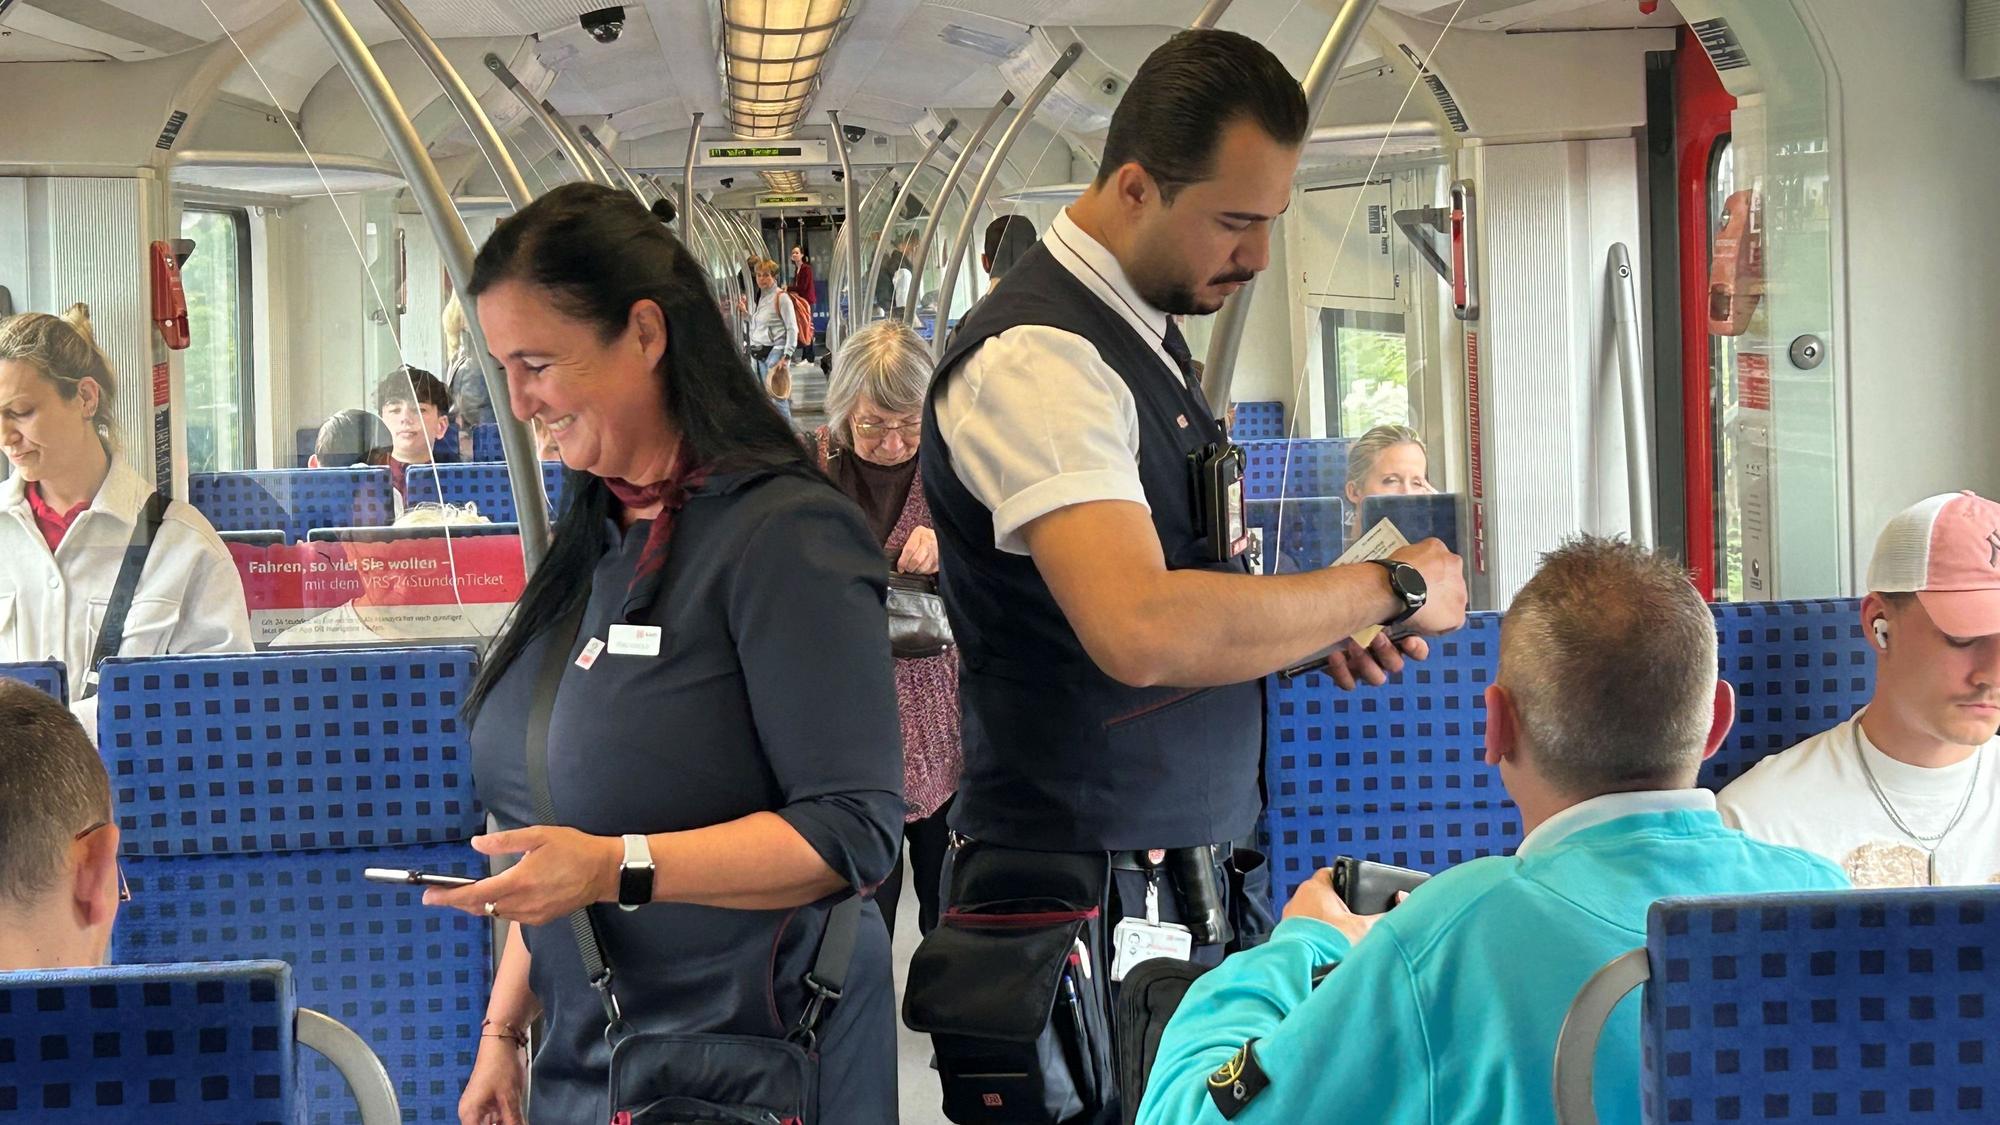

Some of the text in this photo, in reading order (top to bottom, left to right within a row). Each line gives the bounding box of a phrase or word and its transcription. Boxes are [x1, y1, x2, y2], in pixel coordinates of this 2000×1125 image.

[249, 561, 306, 575] Fahren,
[310, 562, 327, 572] so
[331, 558, 358, 572] viel
[361, 557, 385, 571] Sie
[388, 556, 437, 571] wollen
[305, 577, 326, 591] mit
[330, 576, 359, 590] dem
